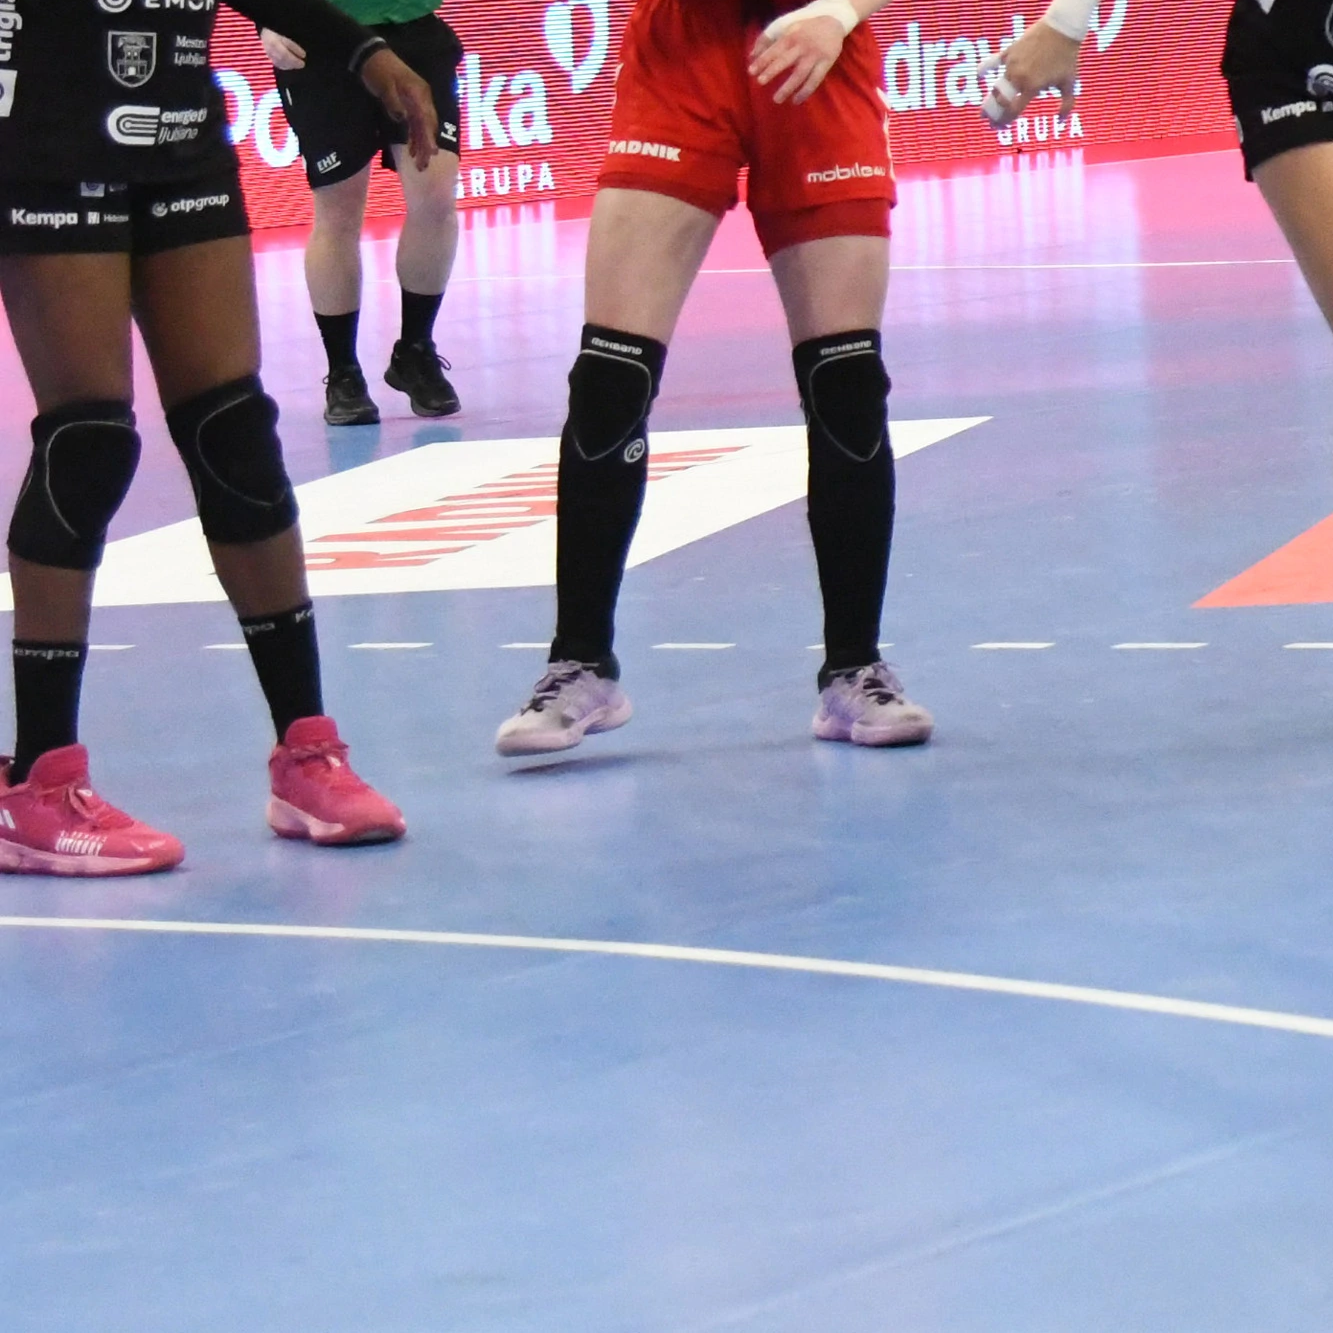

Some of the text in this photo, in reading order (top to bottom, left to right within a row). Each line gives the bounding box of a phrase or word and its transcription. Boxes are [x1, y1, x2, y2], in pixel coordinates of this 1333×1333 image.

[1261, 100, 1317, 124] Kempa
[170, 194, 230, 213] otpgroup
[11, 208, 79, 229] Kempa
[14, 647, 80, 661] empa
